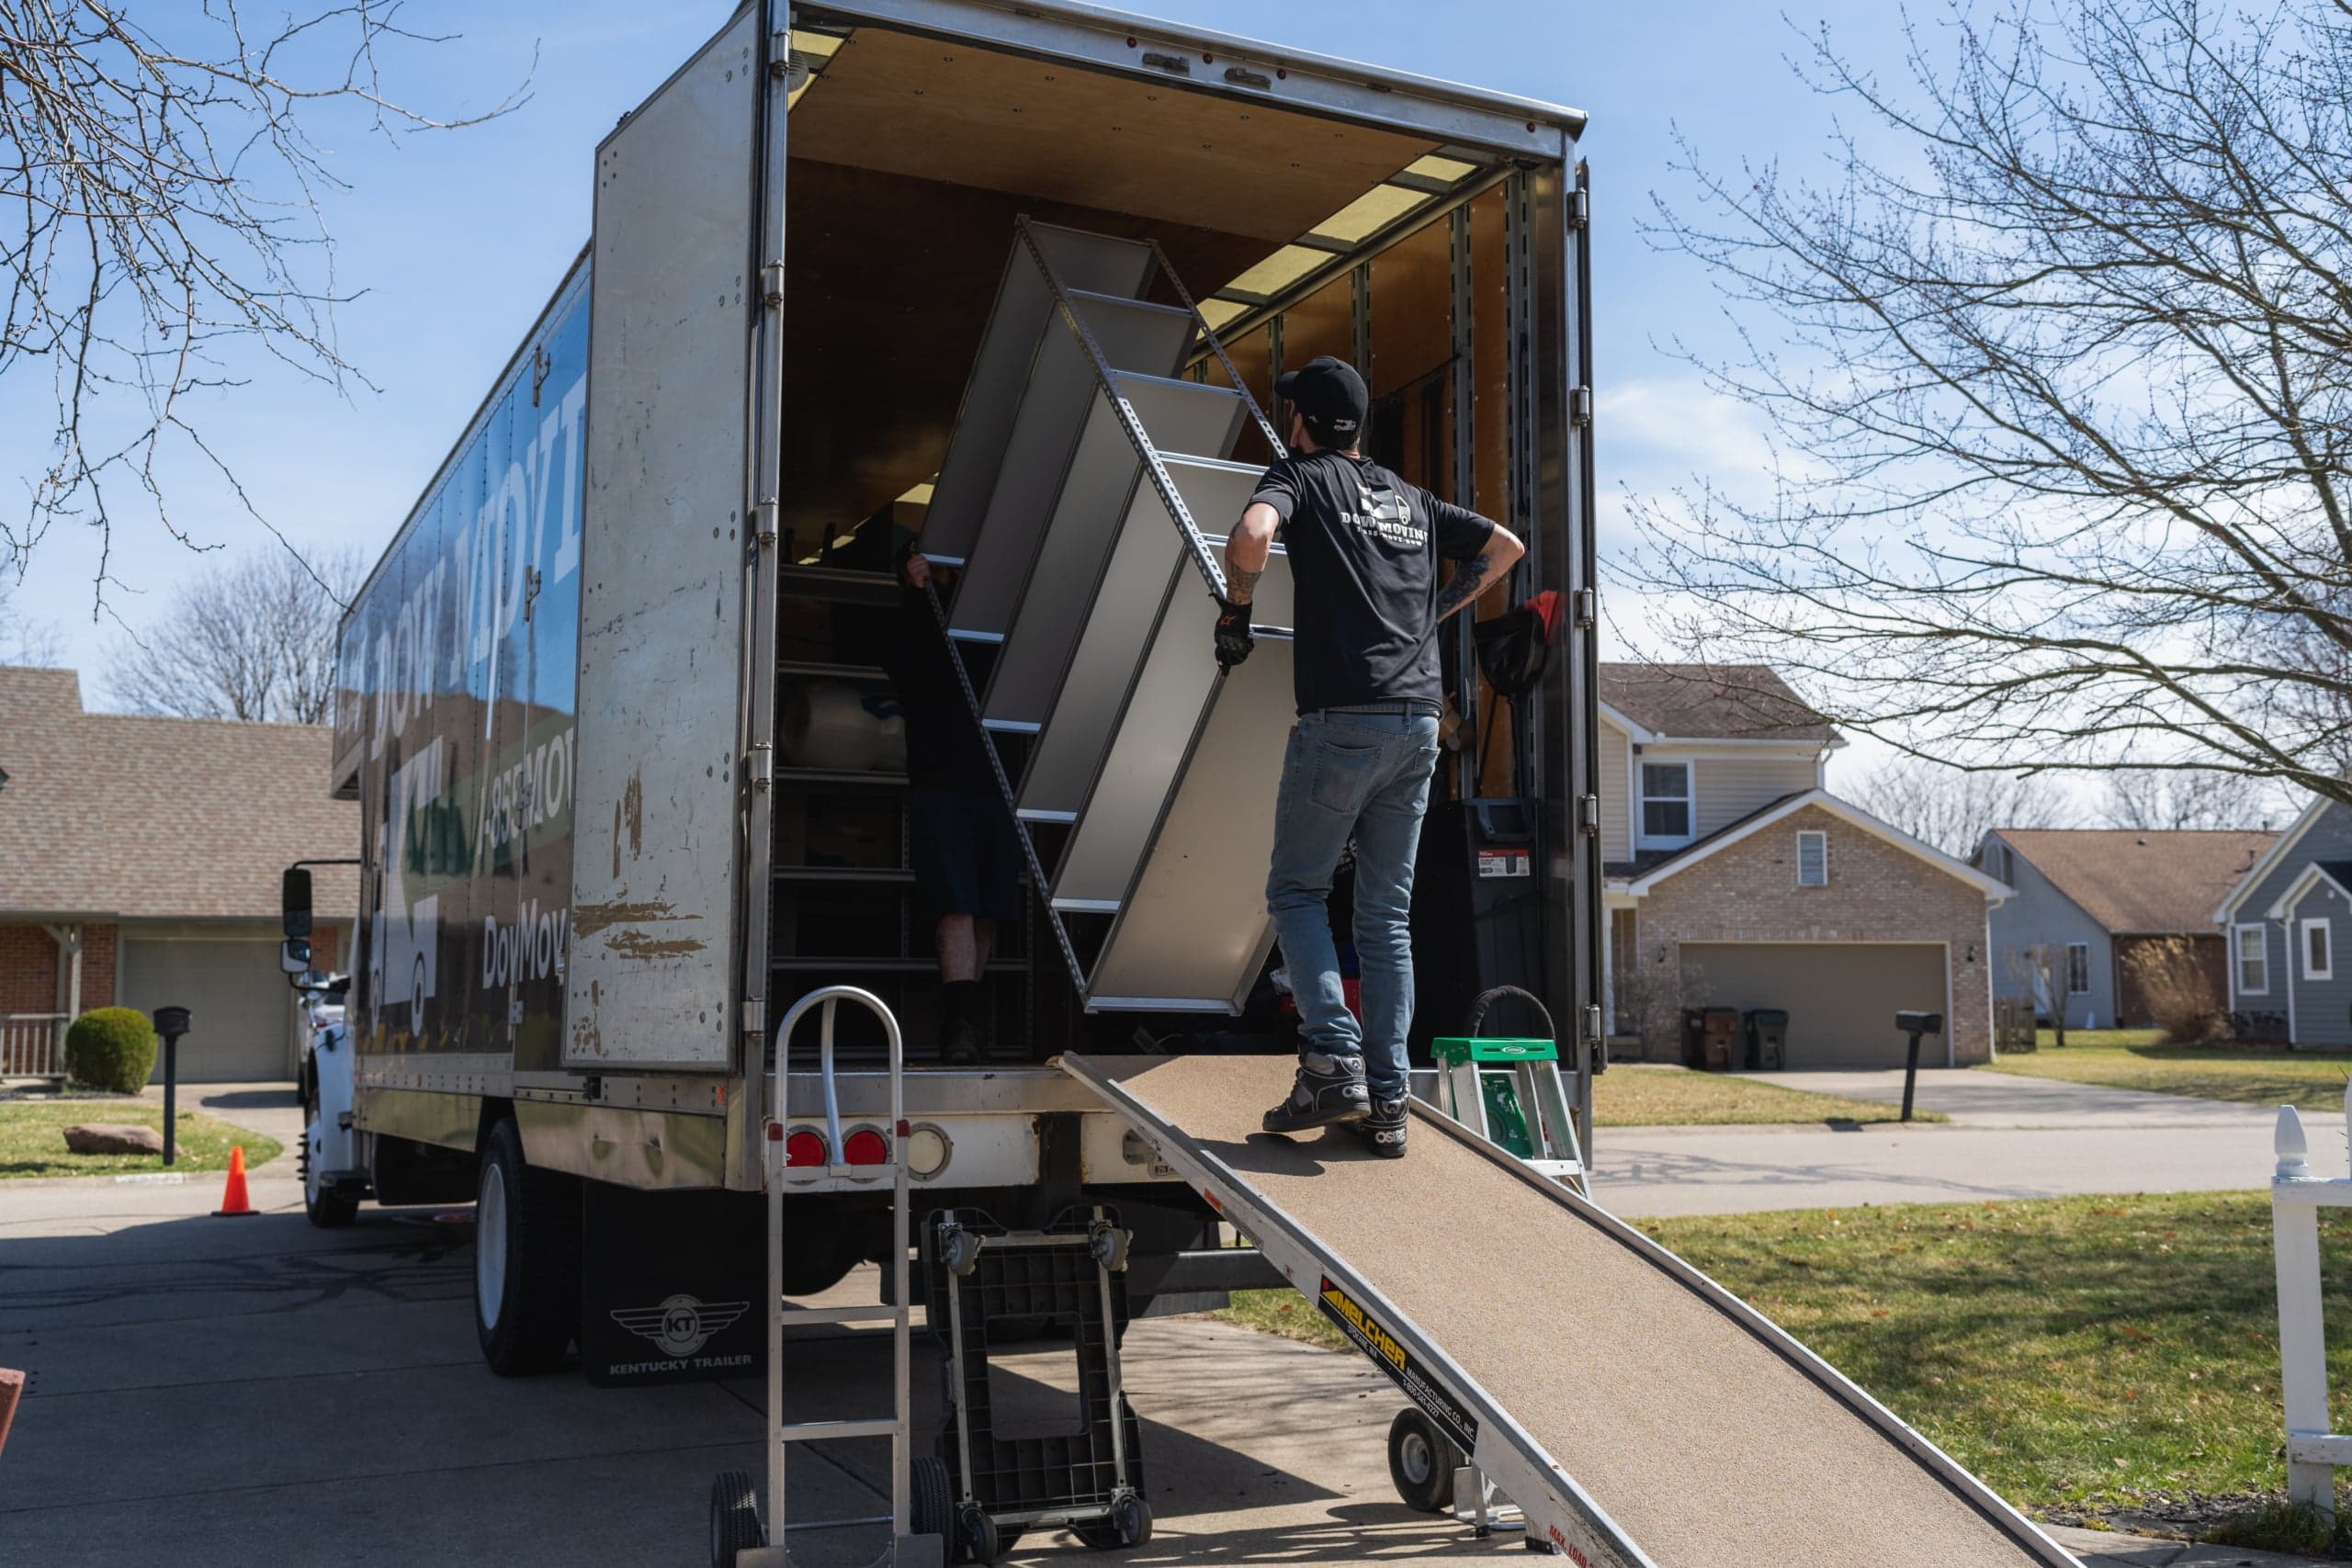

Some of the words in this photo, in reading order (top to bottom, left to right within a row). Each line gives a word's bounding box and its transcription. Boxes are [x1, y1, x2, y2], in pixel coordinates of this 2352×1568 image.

[668, 1316, 695, 1333] KT
[610, 1359, 688, 1375] KENTUCKY
[694, 1355, 752, 1369] TRAILER
[1407, 1367, 1452, 1416] MANUFACTURING
[1549, 1525, 1566, 1551] MAX.
